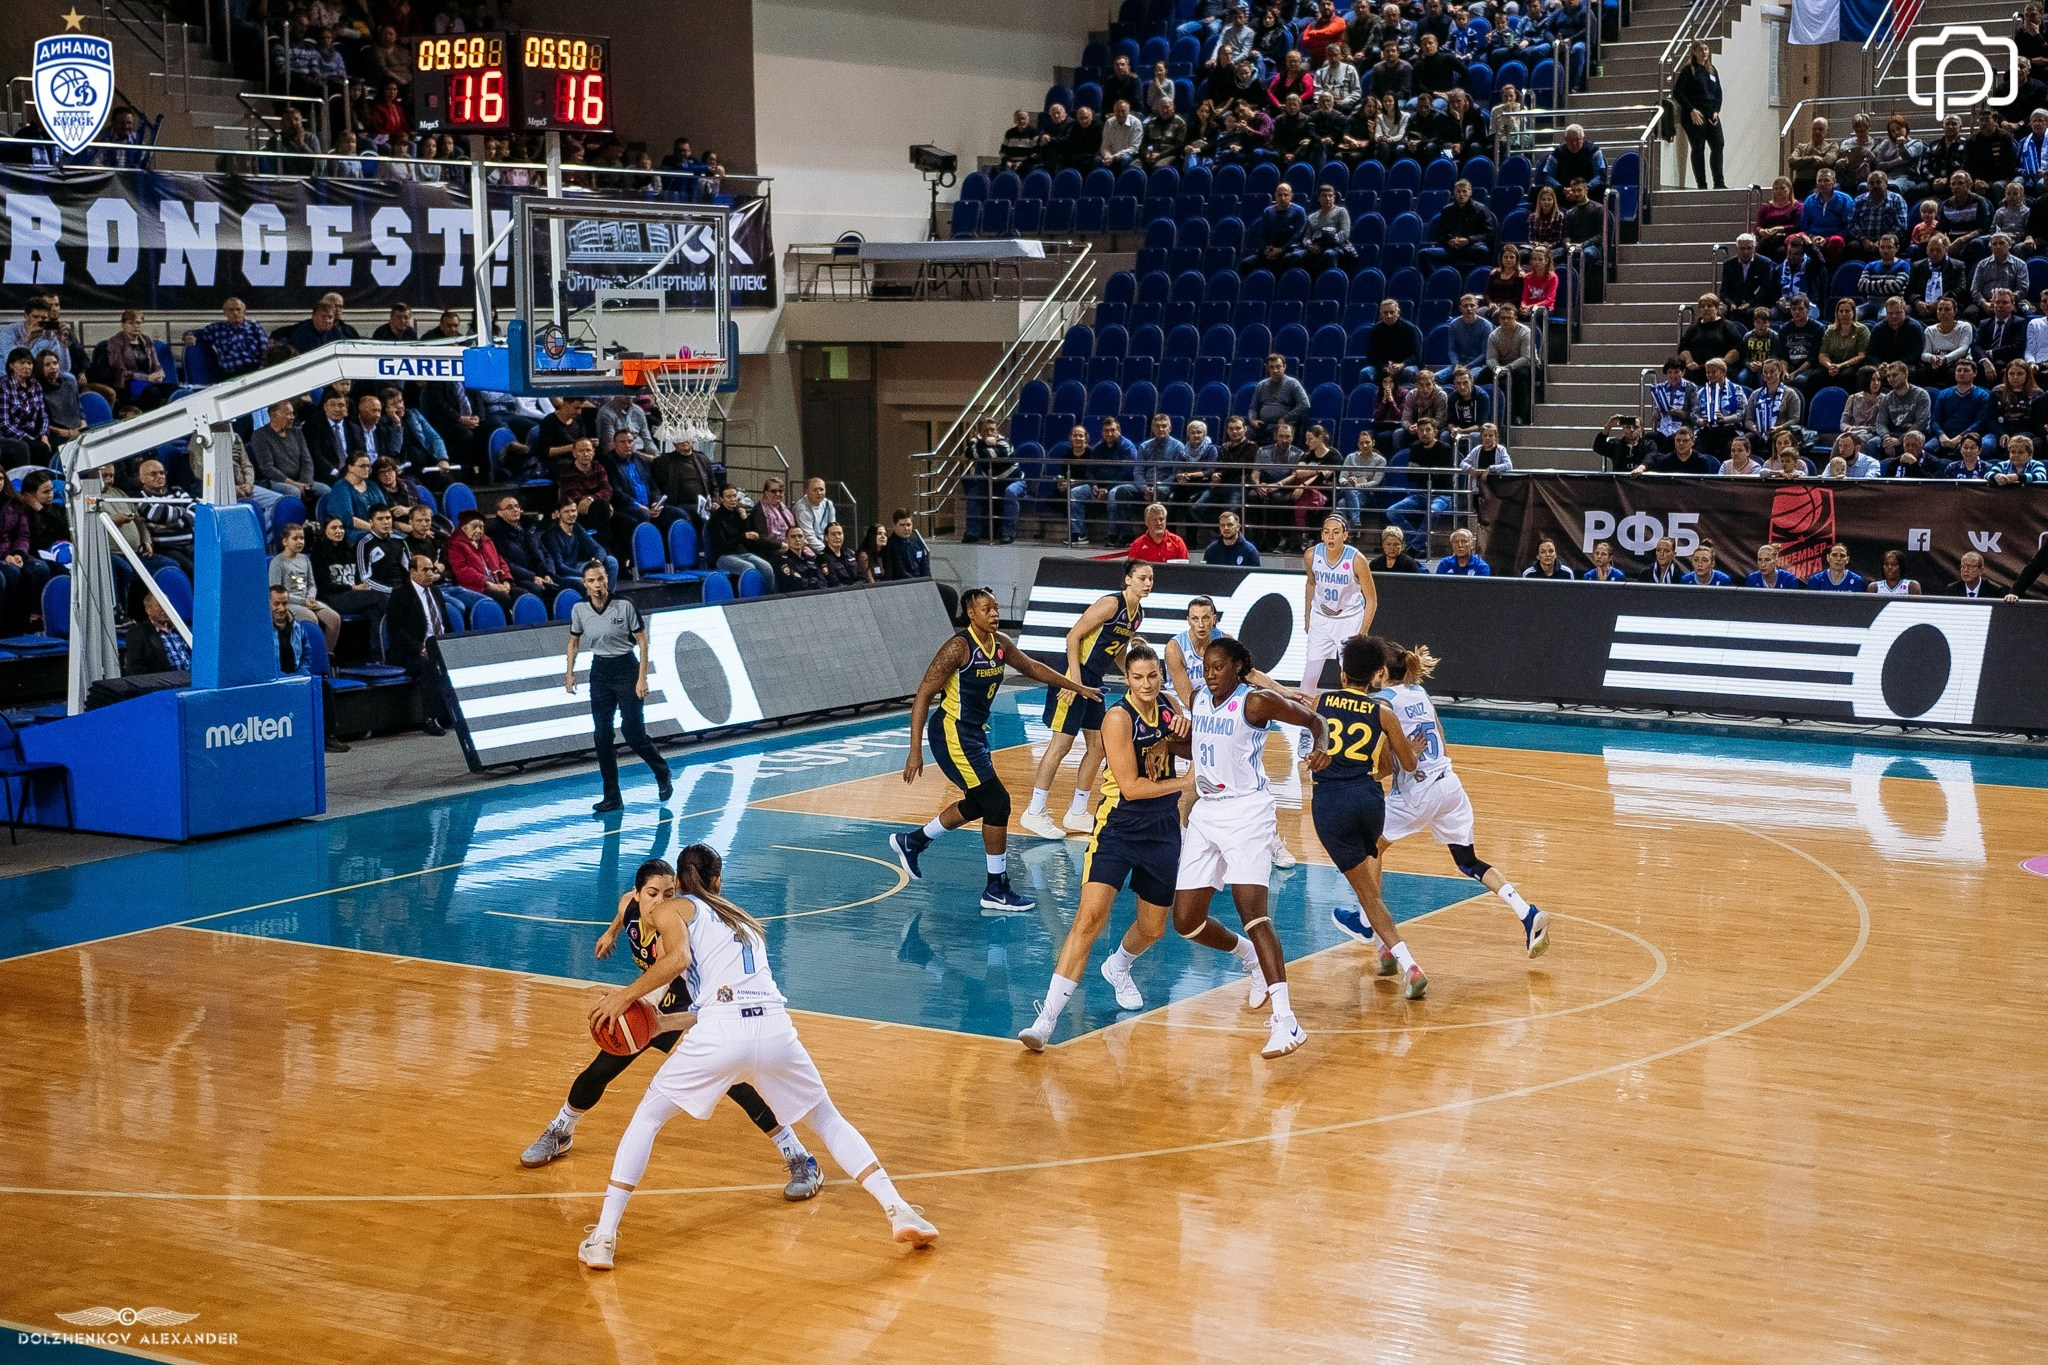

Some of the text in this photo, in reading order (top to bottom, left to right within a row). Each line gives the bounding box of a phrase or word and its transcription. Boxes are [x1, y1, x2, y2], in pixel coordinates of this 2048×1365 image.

[463, 71, 503, 123] 16
[567, 74, 604, 125] 16
[378, 357, 464, 376] GARED
[1582, 510, 1700, 557] РФБ
[1314, 570, 1349, 585] DYNAMO
[1324, 588, 1339, 602] 30
[987, 682, 997, 700] 8
[1325, 695, 1375, 714] HARTLEY
[1404, 702, 1428, 720] CRUZ
[205, 715, 293, 749] molten
[1326, 717, 1373, 762] 32
[1200, 743, 1215, 767] 31
